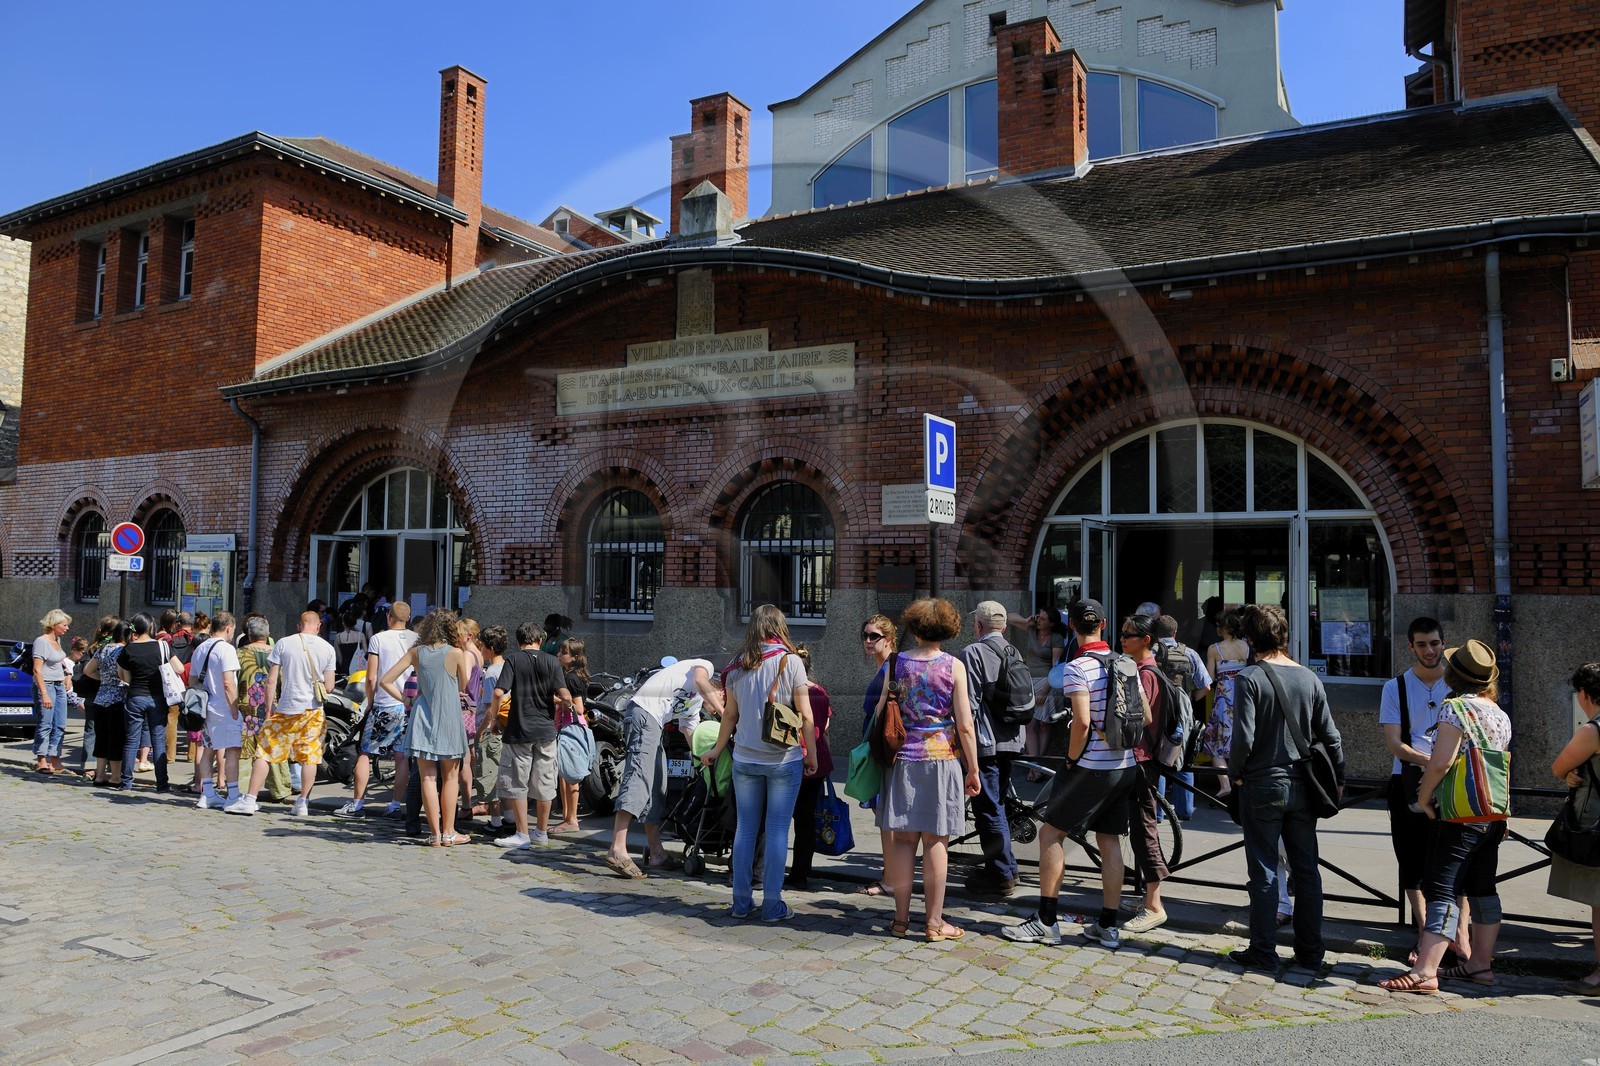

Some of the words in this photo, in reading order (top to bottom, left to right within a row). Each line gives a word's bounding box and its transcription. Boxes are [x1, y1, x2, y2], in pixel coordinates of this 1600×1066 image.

[631, 342, 679, 361] VILLE
[683, 340, 706, 358] DE
[710, 335, 763, 354] PARIS
[580, 361, 712, 389] ETABLISSEMENT
[716, 350, 823, 375] BALNEAIRE
[586, 390, 608, 406] DE
[612, 388, 634, 404] LA
[636, 382, 693, 401] BUTTE
[695, 378, 733, 395] AUX
[737, 370, 815, 391] CAILLES
[936, 432, 948, 476] P
[929, 497, 935, 514] 2
[934, 498, 955, 516] ROUES
